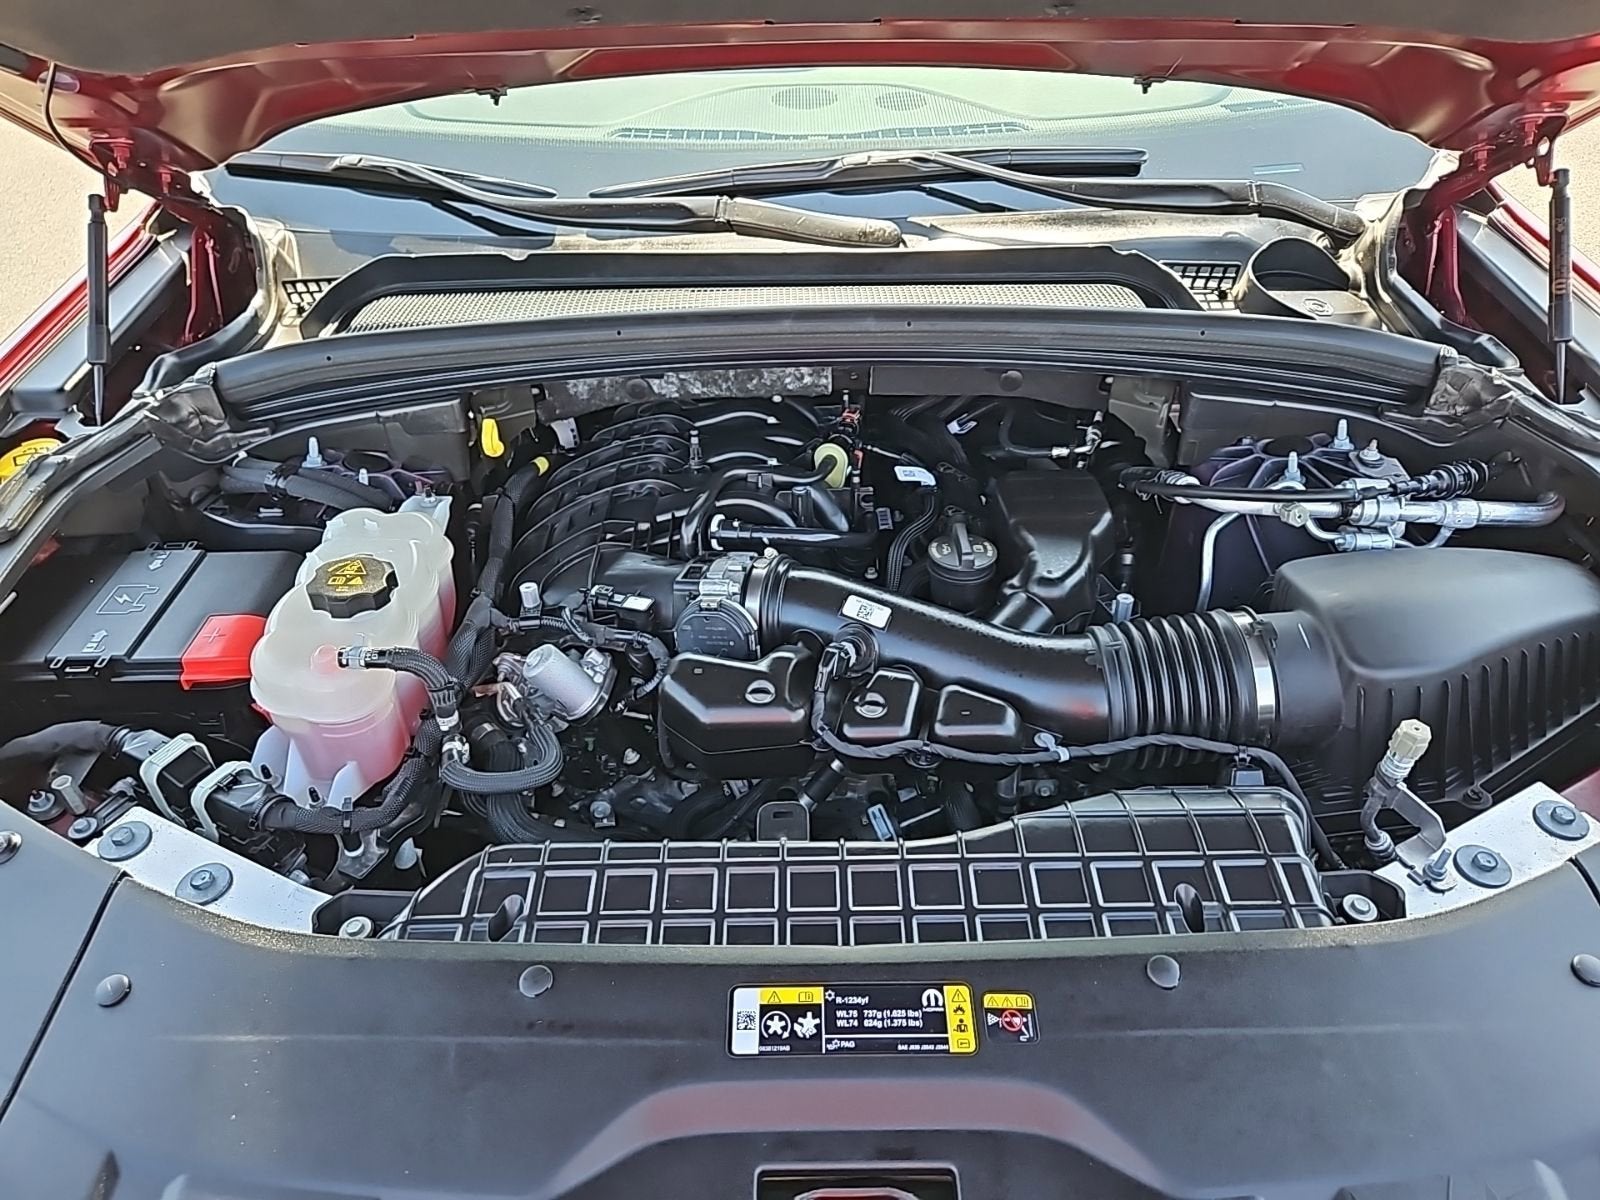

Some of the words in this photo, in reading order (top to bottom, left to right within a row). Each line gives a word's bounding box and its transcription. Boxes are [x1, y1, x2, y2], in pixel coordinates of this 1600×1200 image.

[835, 996, 869, 1006] R-1234yf
[835, 1009, 859, 1018] WL75
[863, 1009, 883, 1019] 737g
[907, 1009, 923, 1019] lbs)
[836, 1018, 859, 1028] WL74
[883, 1018, 907, 1029] (1.375
[907, 1018, 924, 1029] lbs)
